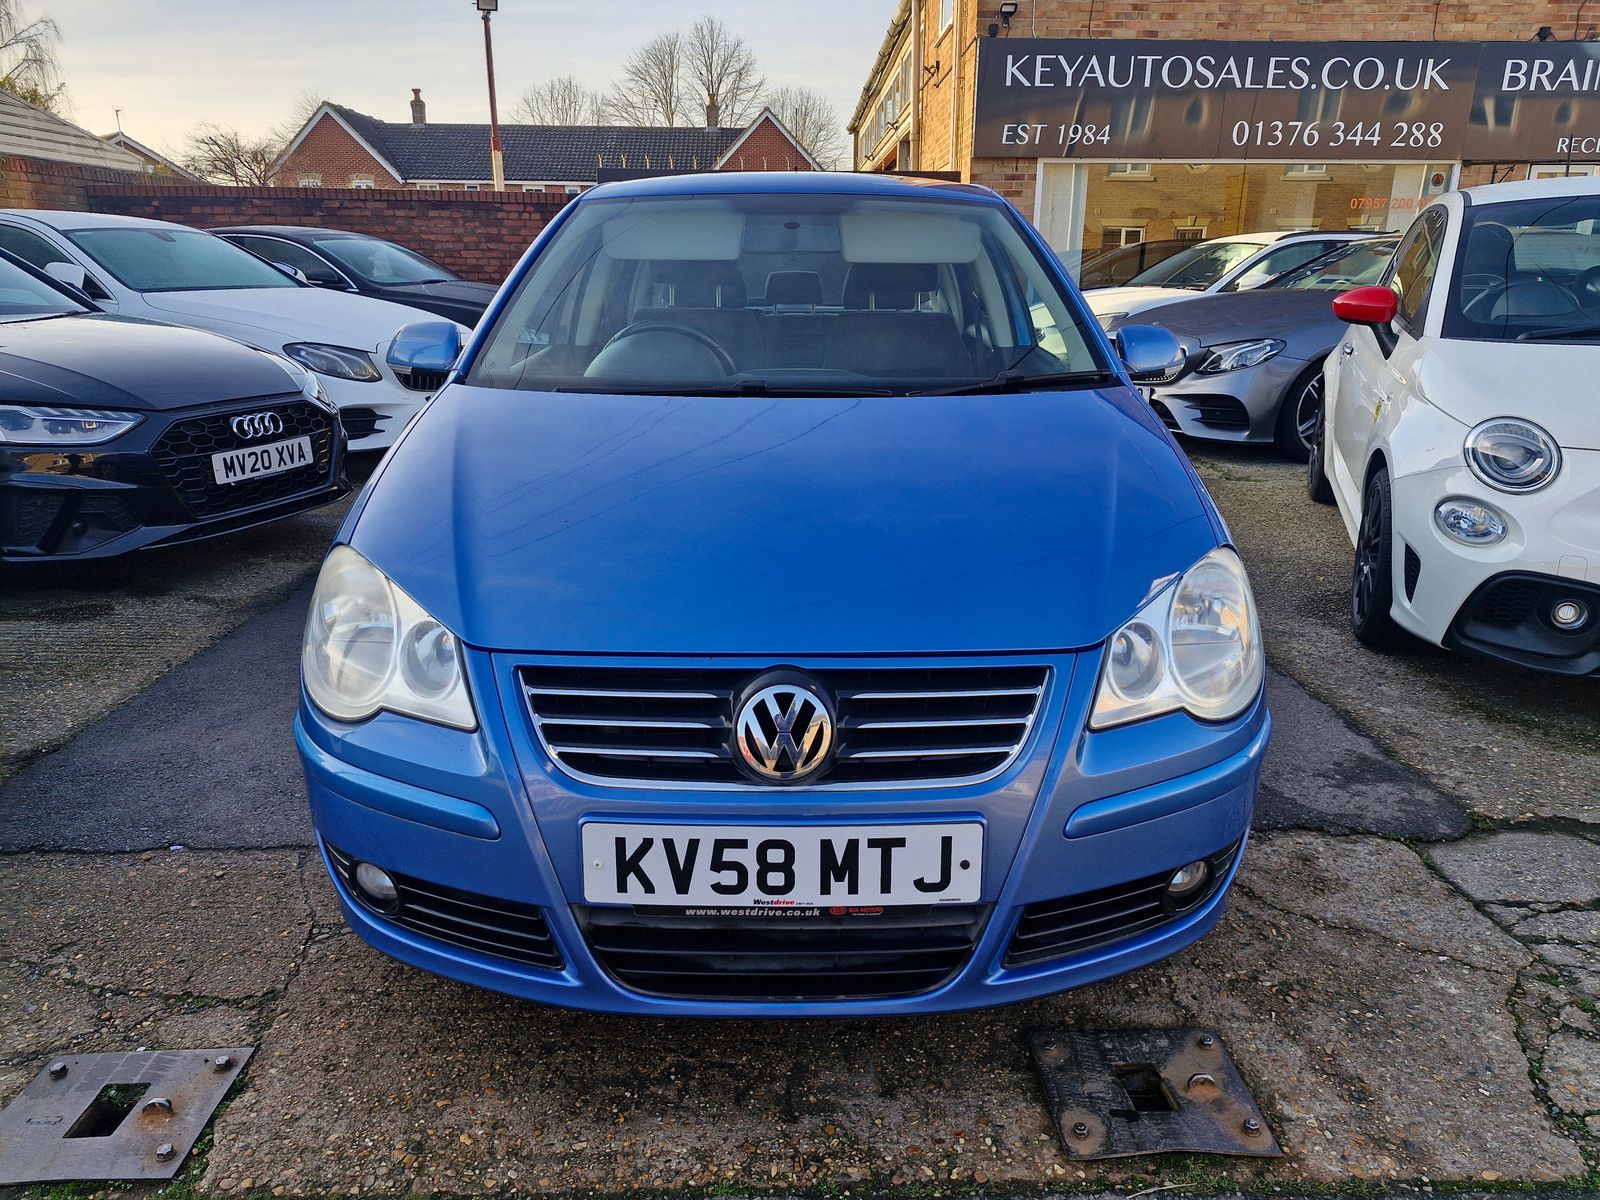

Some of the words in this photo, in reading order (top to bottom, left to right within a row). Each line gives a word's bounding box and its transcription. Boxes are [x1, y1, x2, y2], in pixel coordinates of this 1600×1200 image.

[1005, 54, 1451, 91] KEYAUTOSALES.CO.UK
[1001, 123, 1048, 145] EST
[1057, 123, 1111, 145] 1984
[1232, 120, 1321, 146] 01376
[1329, 121, 1382, 147] 344
[1390, 122, 1444, 147] 288
[1350, 197, 1388, 209] 07957
[222, 449, 272, 479] MV20
[275, 441, 307, 467] XVA
[614, 836, 796, 896] KV58
[819, 835, 953, 896] MTJ
[685, 907, 821, 917] www.westdrive.co.uk
[753, 898, 795, 906] Westdrive
